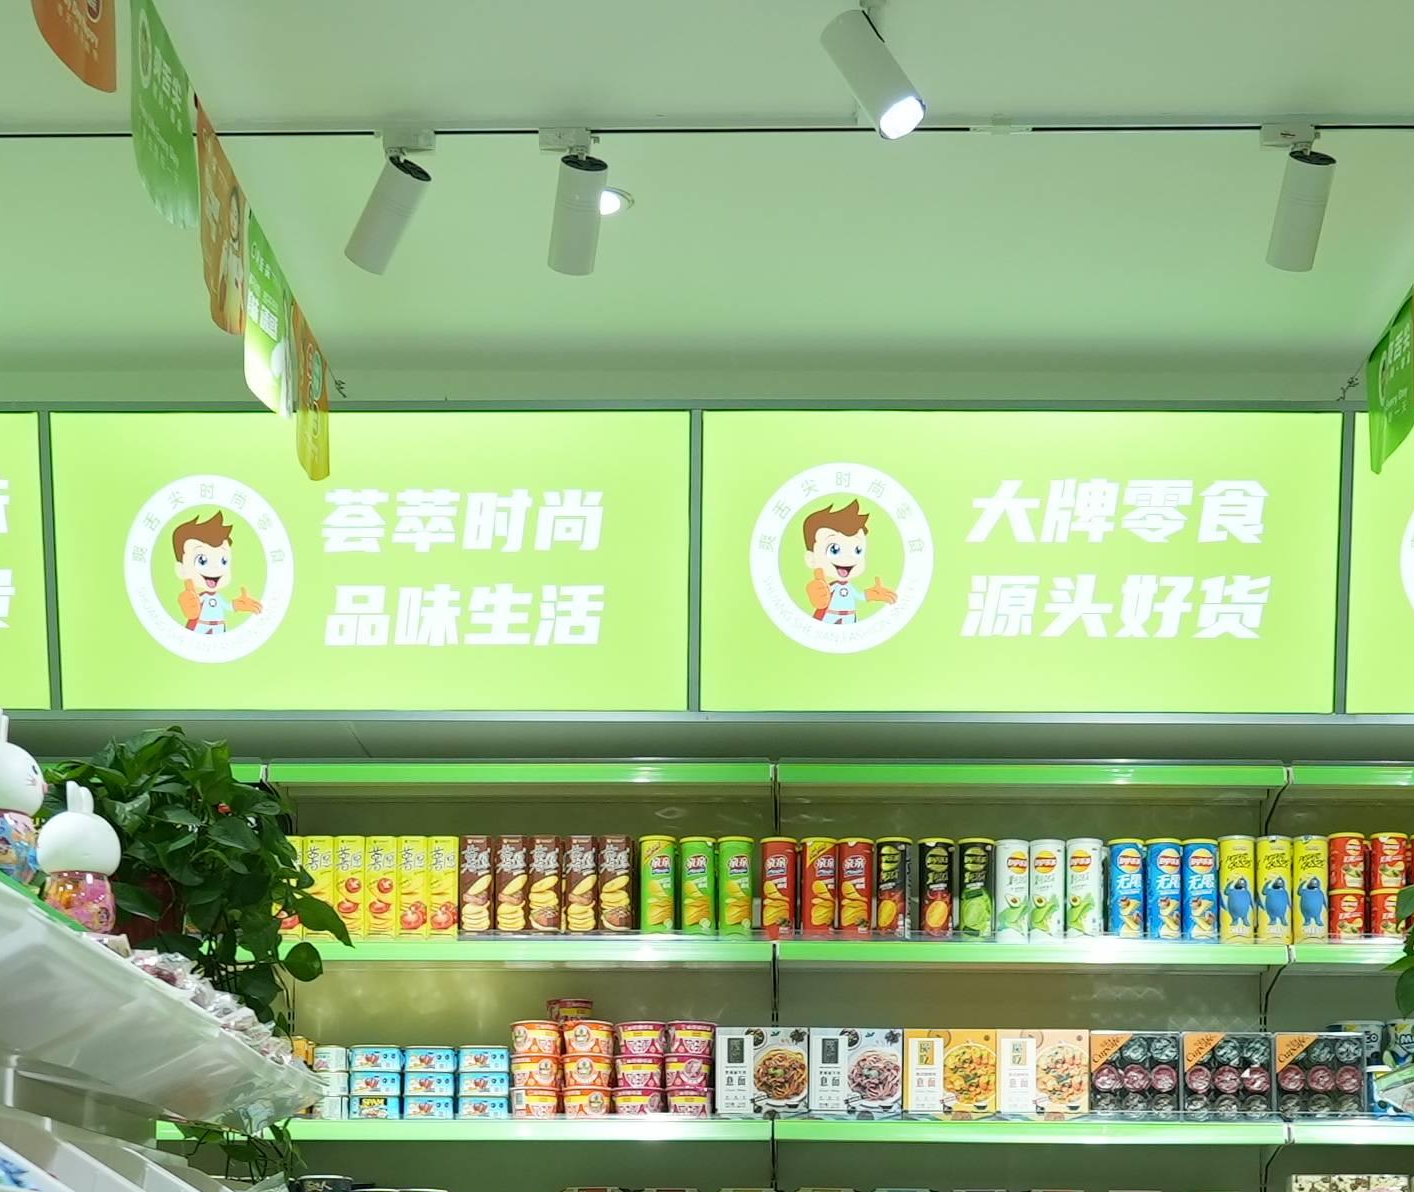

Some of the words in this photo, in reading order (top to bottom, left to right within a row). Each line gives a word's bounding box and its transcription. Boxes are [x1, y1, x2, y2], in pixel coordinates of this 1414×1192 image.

[325, 489, 602, 552] 荟萃时尚
[969, 479, 1267, 542] 大牌零食
[326, 584, 603, 646] 品味生活
[963, 575, 1270, 637] 源头好货
[361, 1098, 385, 1107] SPAM
